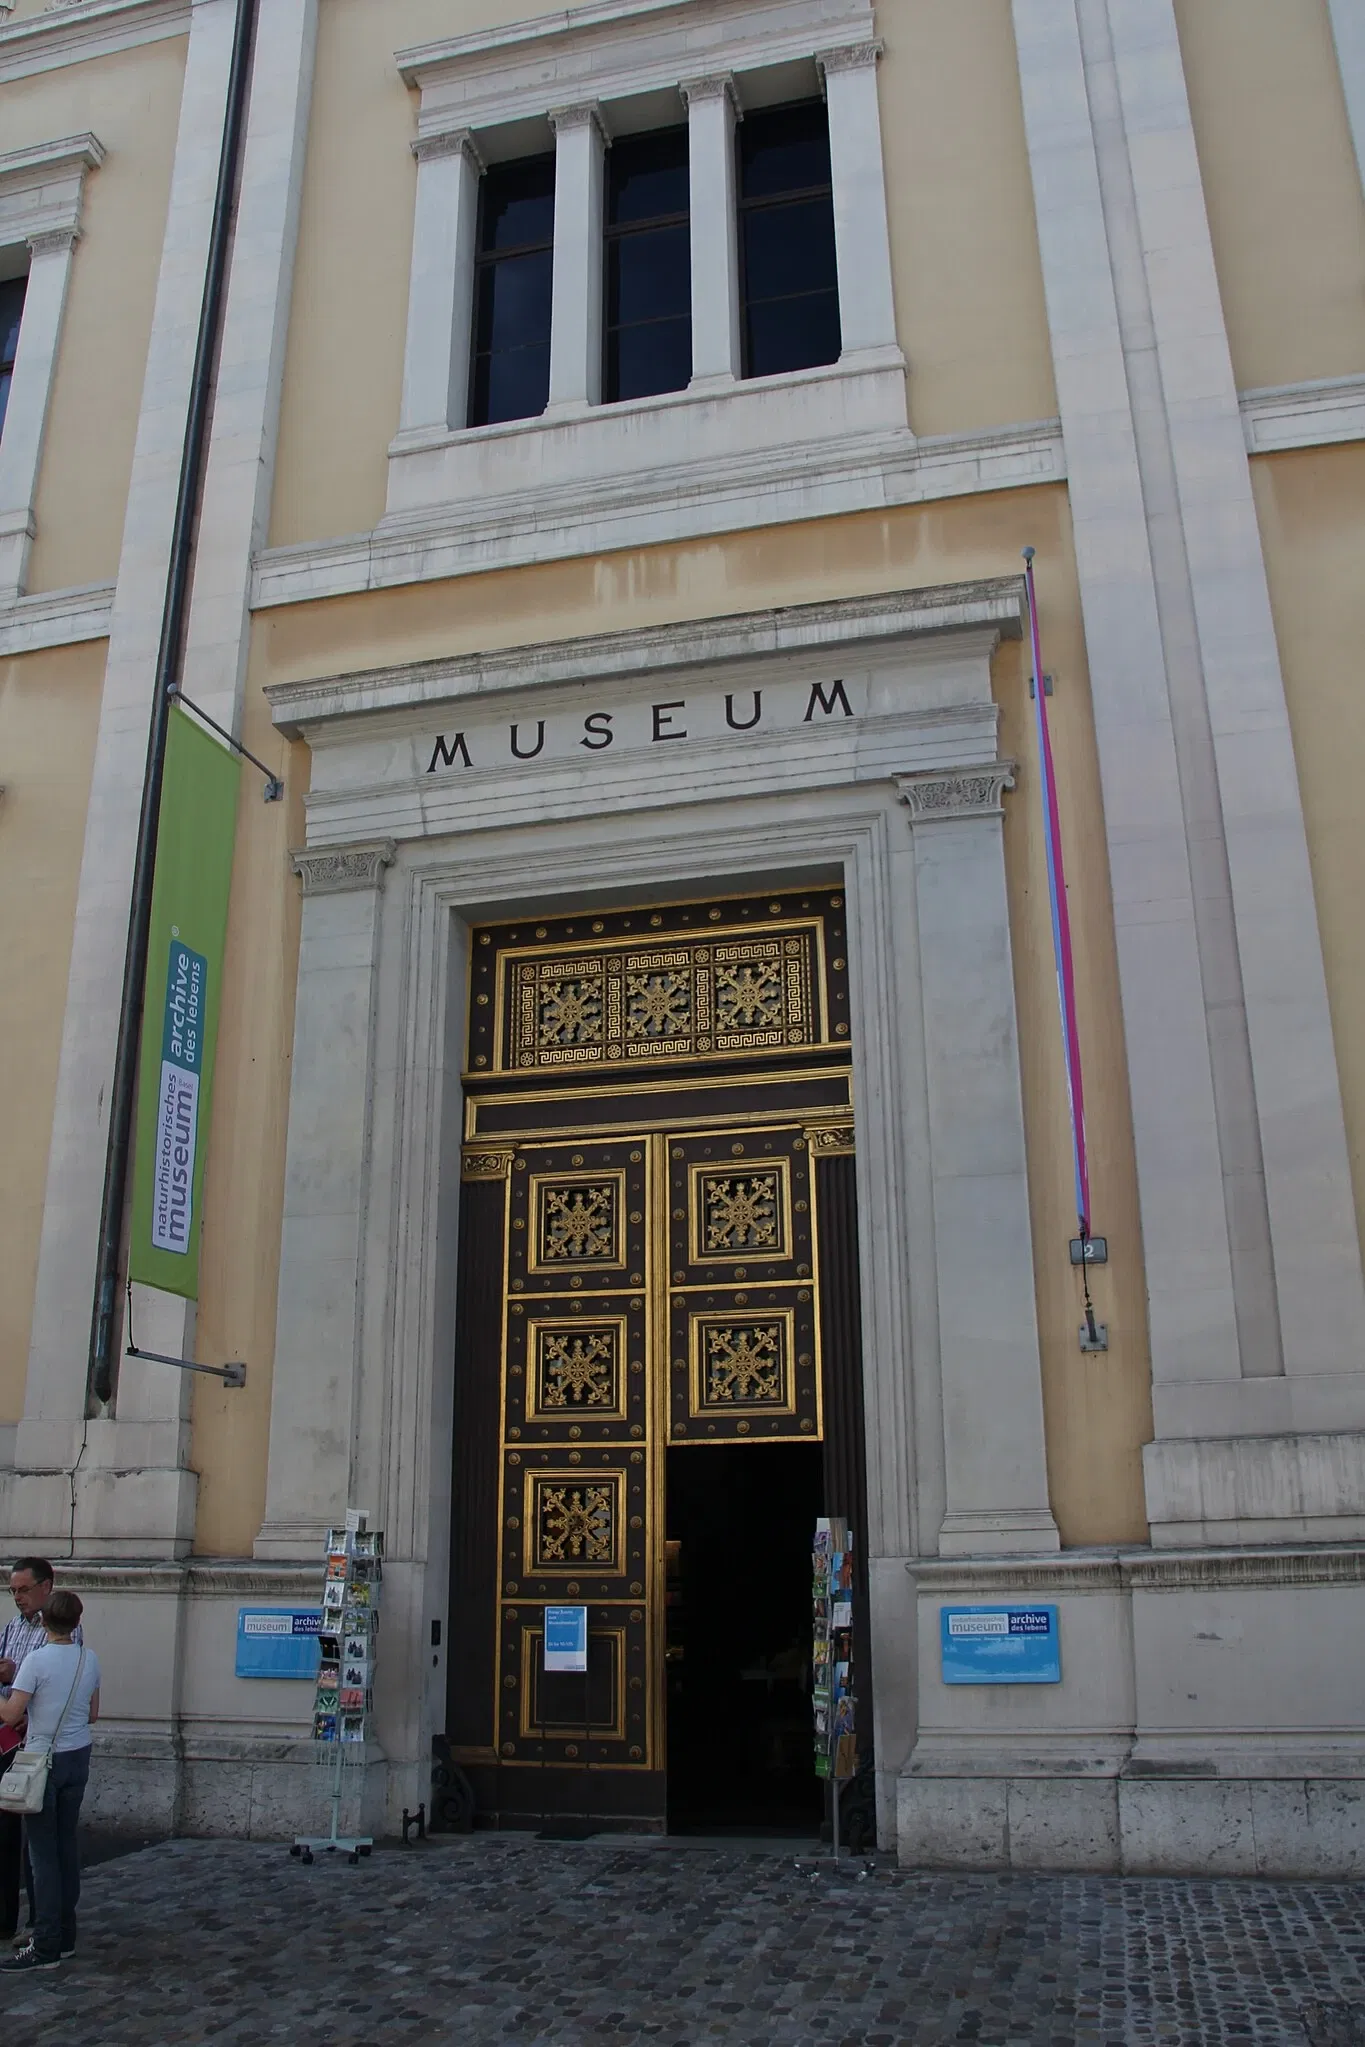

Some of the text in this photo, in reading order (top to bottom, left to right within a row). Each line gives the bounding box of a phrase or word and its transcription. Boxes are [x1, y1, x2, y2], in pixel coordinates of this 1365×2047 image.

[427, 679, 854, 772] MUSEUM
[169, 953, 190, 1057] archive
[183, 961, 200, 1063] des lebens
[157, 1073, 177, 1237] naturhistorisches
[169, 1090, 193, 1242] museum
[1084, 1244, 1094, 1257] 2
[247, 1623, 287, 1632] museum
[952, 1623, 1002, 1633] museum
[1010, 1613, 1047, 1624] archive
